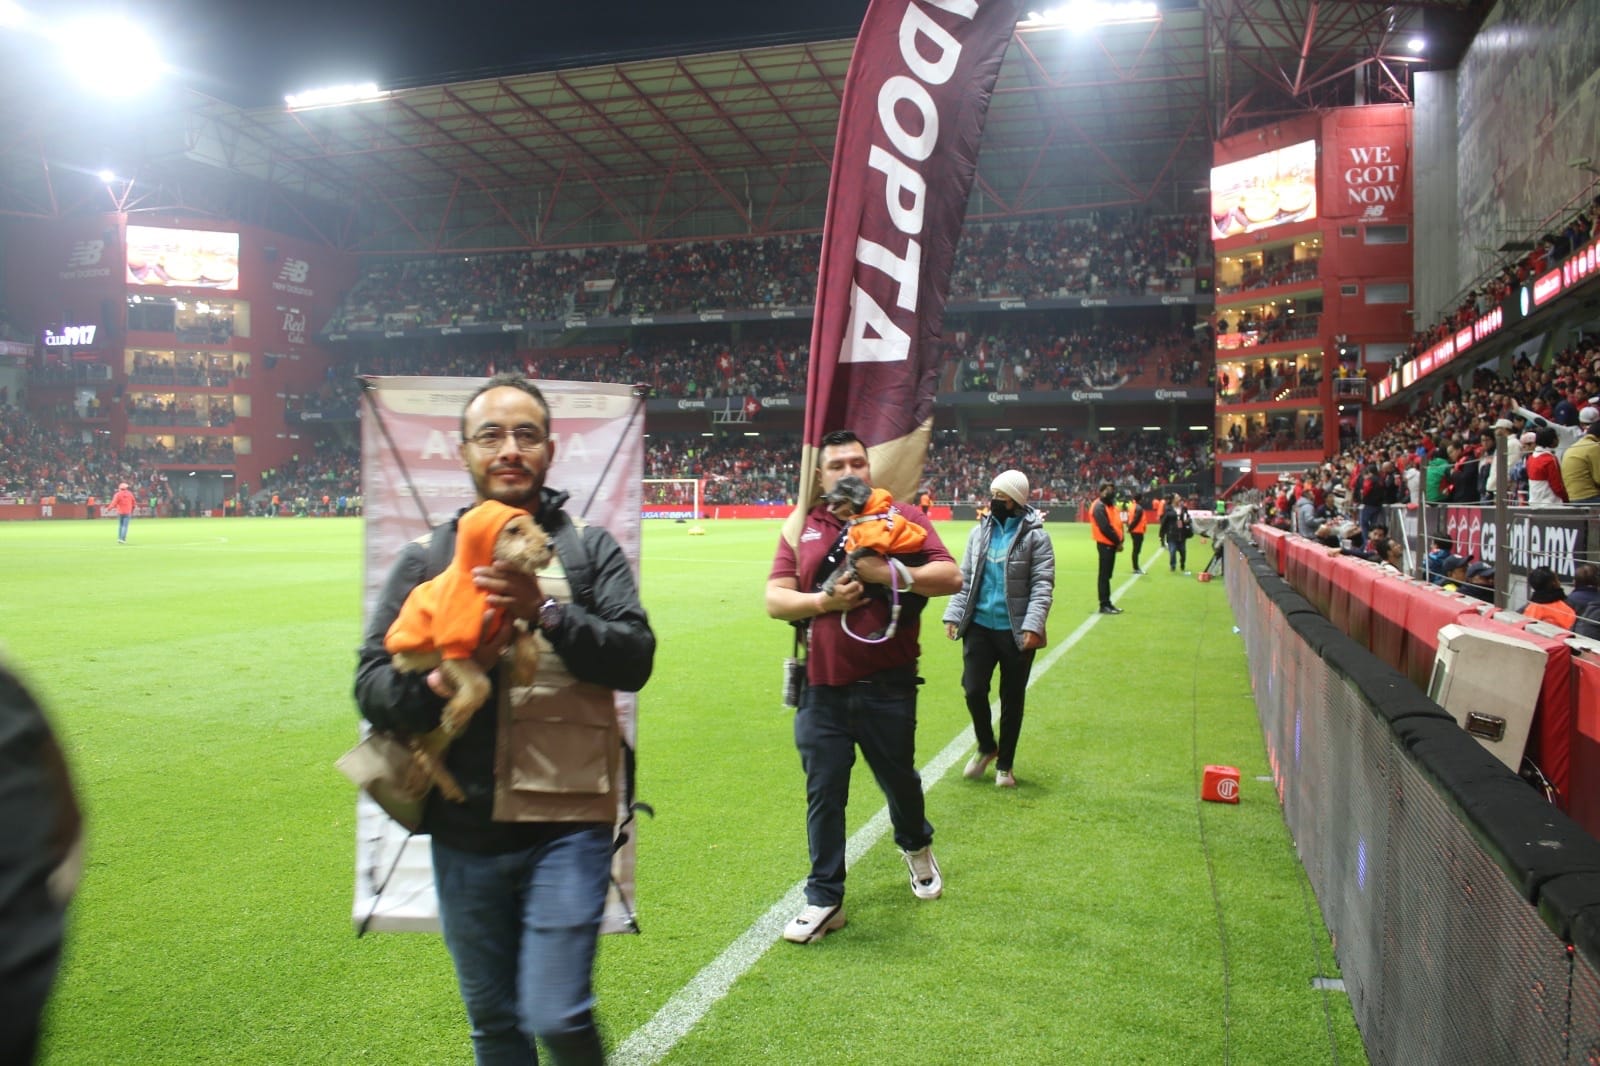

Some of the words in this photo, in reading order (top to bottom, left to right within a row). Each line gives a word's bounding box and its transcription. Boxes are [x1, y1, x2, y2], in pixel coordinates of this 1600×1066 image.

[1349, 146, 1392, 164] WE
[1345, 165, 1399, 185] GOT
[1348, 184, 1399, 205] NOW
[1481, 518, 1578, 577] cante.mx
